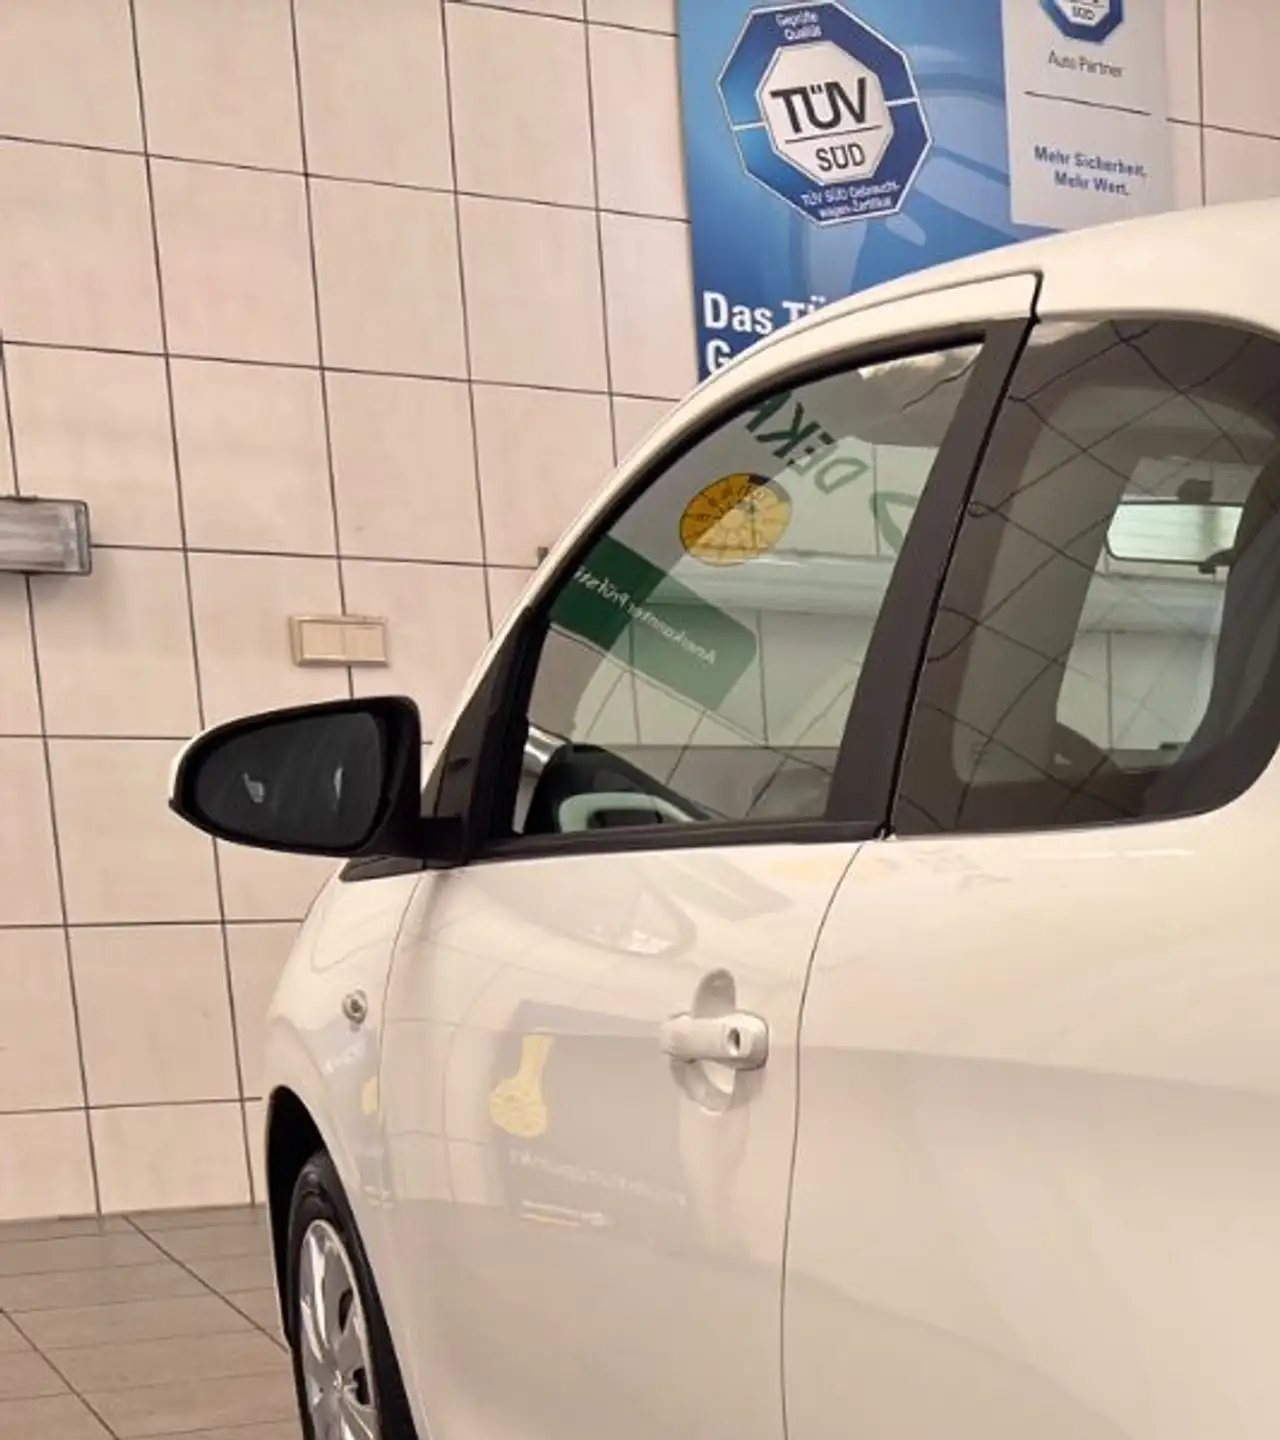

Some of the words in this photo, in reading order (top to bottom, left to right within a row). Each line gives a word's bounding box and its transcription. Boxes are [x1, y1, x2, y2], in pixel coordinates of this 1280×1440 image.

[1049, 50, 1077, 70] Auto
[1080, 56, 1124, 77] Partner
[770, 77, 867, 134] TÜV
[816, 142, 866, 172] SÜD
[1034, 145, 1070, 165] Mehr
[1054, 170, 1090, 189] Mehr
[703, 290, 773, 335] Das
